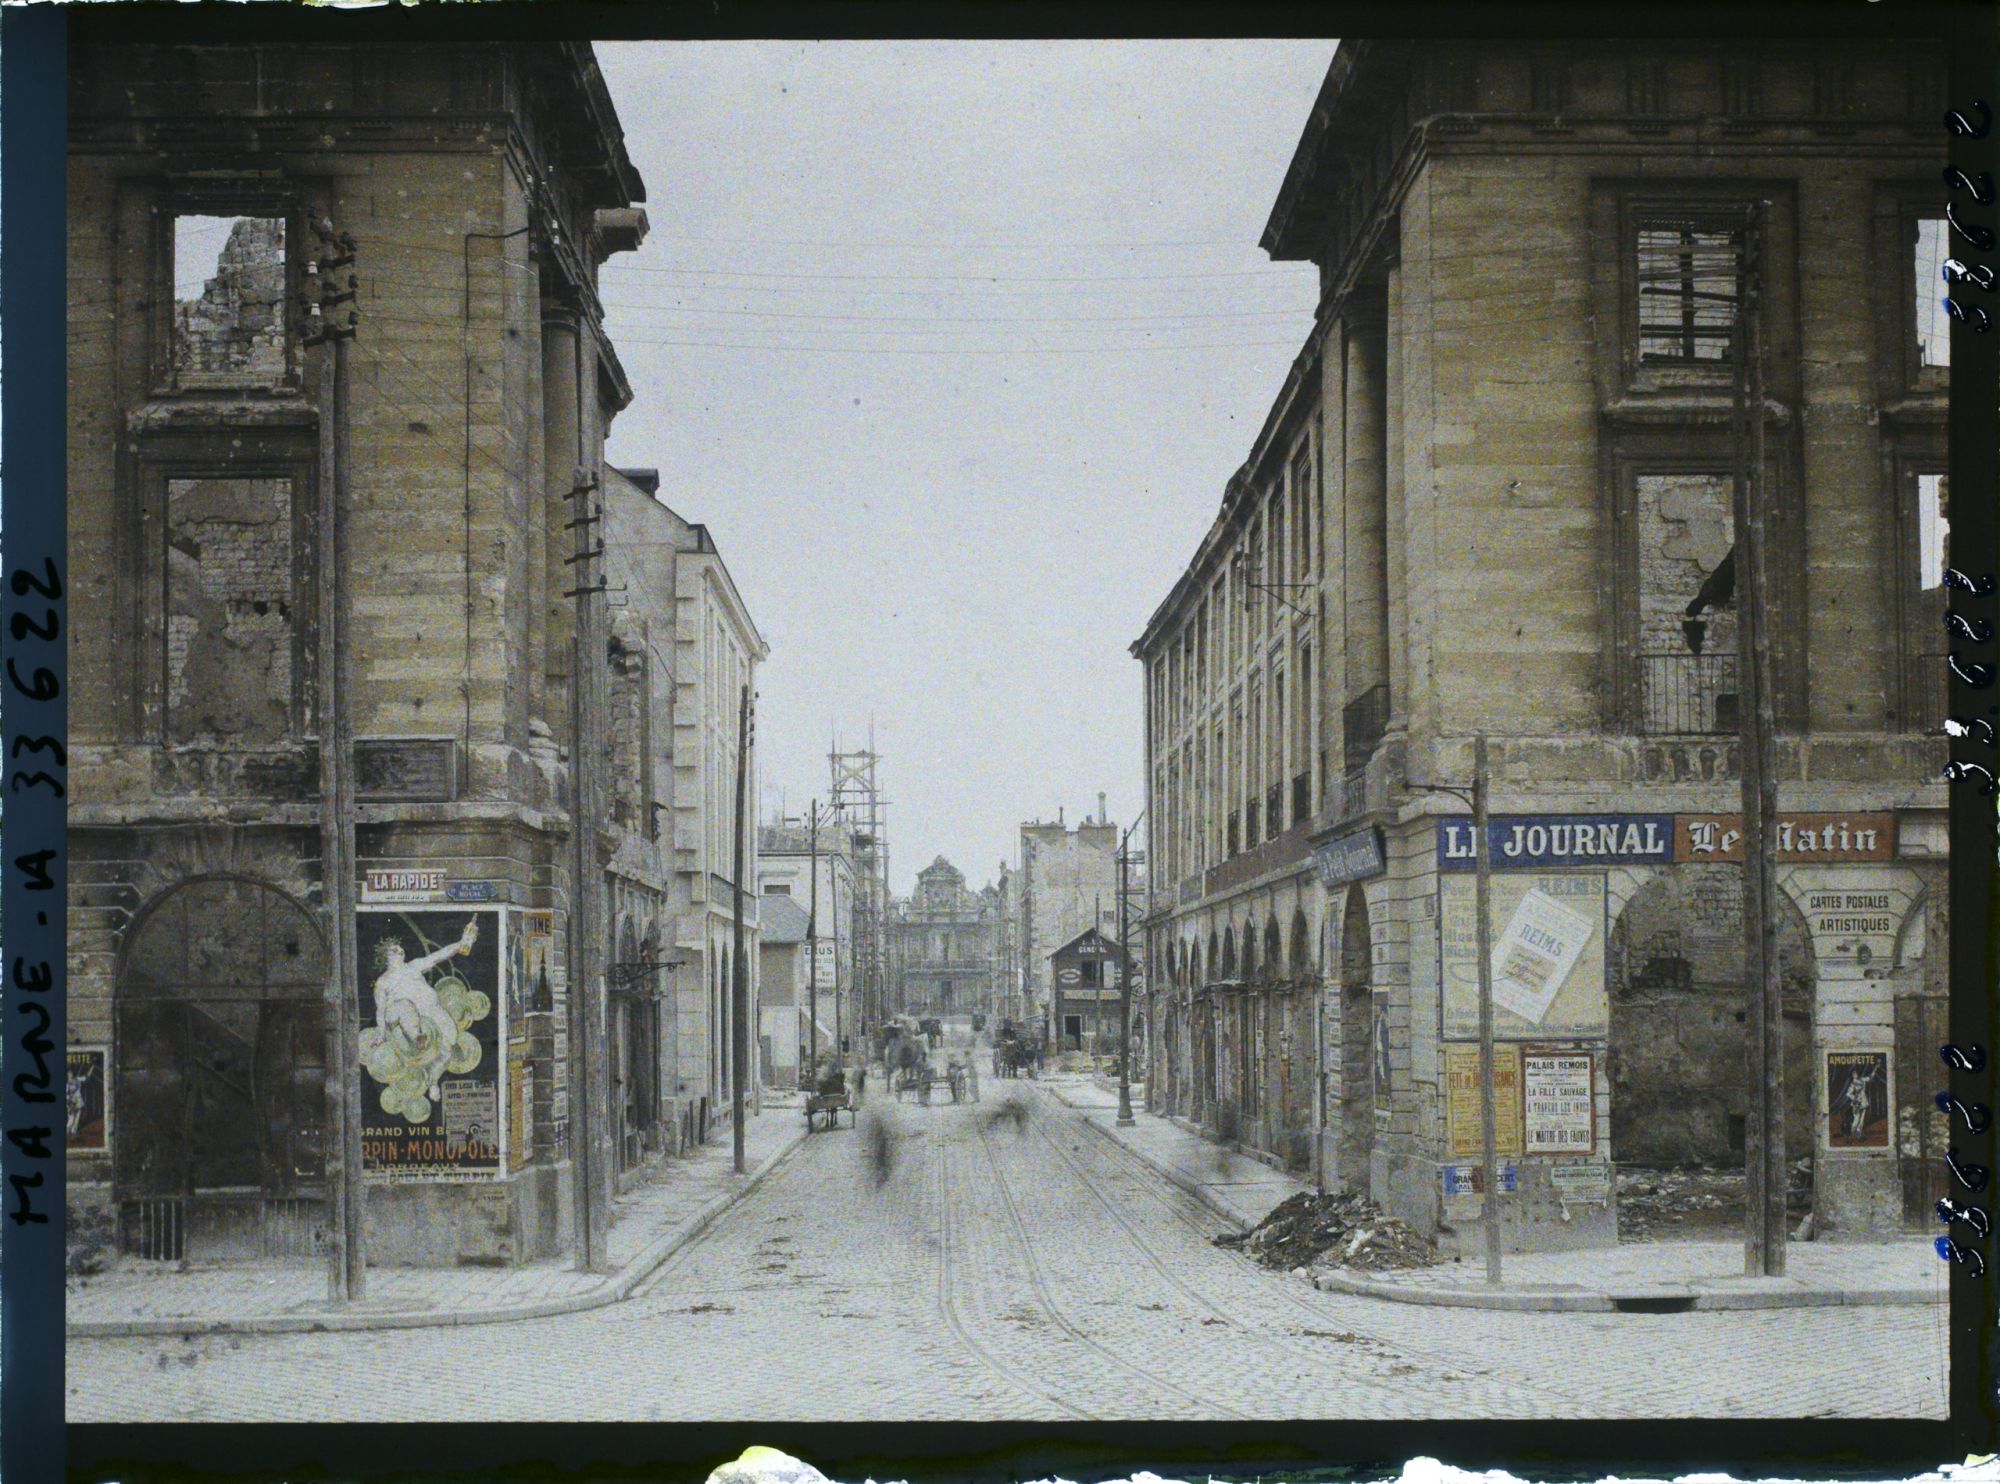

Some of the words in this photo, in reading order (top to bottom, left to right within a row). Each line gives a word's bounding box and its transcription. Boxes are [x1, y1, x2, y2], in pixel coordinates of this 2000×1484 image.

[7, 556, 66, 800] 33622
[1503, 823, 1664, 857] JOURNAL
[1688, 821, 1740, 853] Le
[1538, 877, 1602, 896] REIMS
[1810, 896, 1842, 908] CARTES
[1846, 895, 1889, 908] POSTALES
[1820, 918, 1889, 934] ARTISTIQUES
[1519, 923, 1565, 957] REIMS
[1526, 1061, 1555, 1070] PALAIS
[1558, 1061, 1588, 1069] REMOIS
[1829, 1055, 1876, 1065] AMOURETTE
[11, 958, 56, 1225] MARNE
[1528, 1088, 1536, 1096] LA
[1539, 1088, 1556, 1096] FILLE
[1560, 1087, 1587, 1096] SAUVAGE
[408, 1127, 430, 1136] VIN
